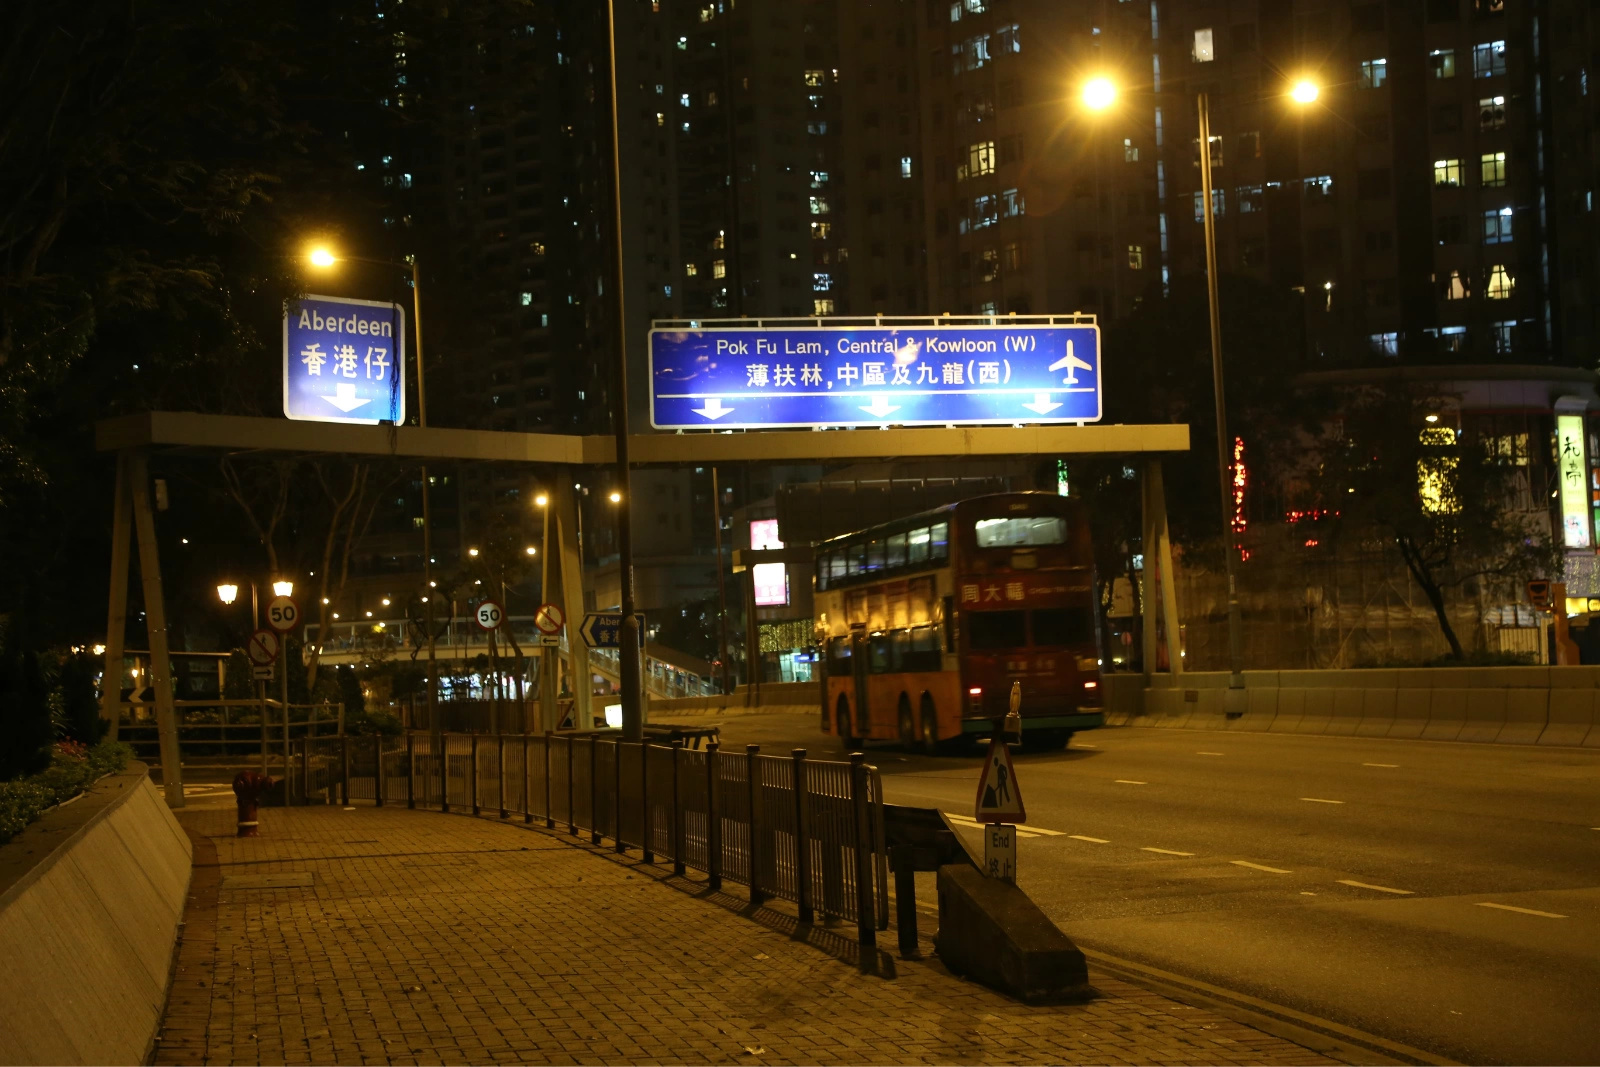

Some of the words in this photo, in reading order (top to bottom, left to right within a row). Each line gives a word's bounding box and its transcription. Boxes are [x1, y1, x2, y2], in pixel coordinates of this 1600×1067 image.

[298, 309, 392, 338] Aberdeen
[716, 339, 748, 355] Pok
[757, 339, 777, 354] Fu
[785, 339, 829, 356] Lam,
[837, 338, 898, 353] Central
[906, 337, 920, 352] &
[926, 337, 996, 352] Kowloon
[1004, 335, 1036, 352] (W)
[300, 342, 391, 381] 香港仔
[961, 582, 1026, 604] 周大福
[272, 606, 295, 622] 50
[480, 609, 500, 622] 50
[992, 832, 1010, 849] End
